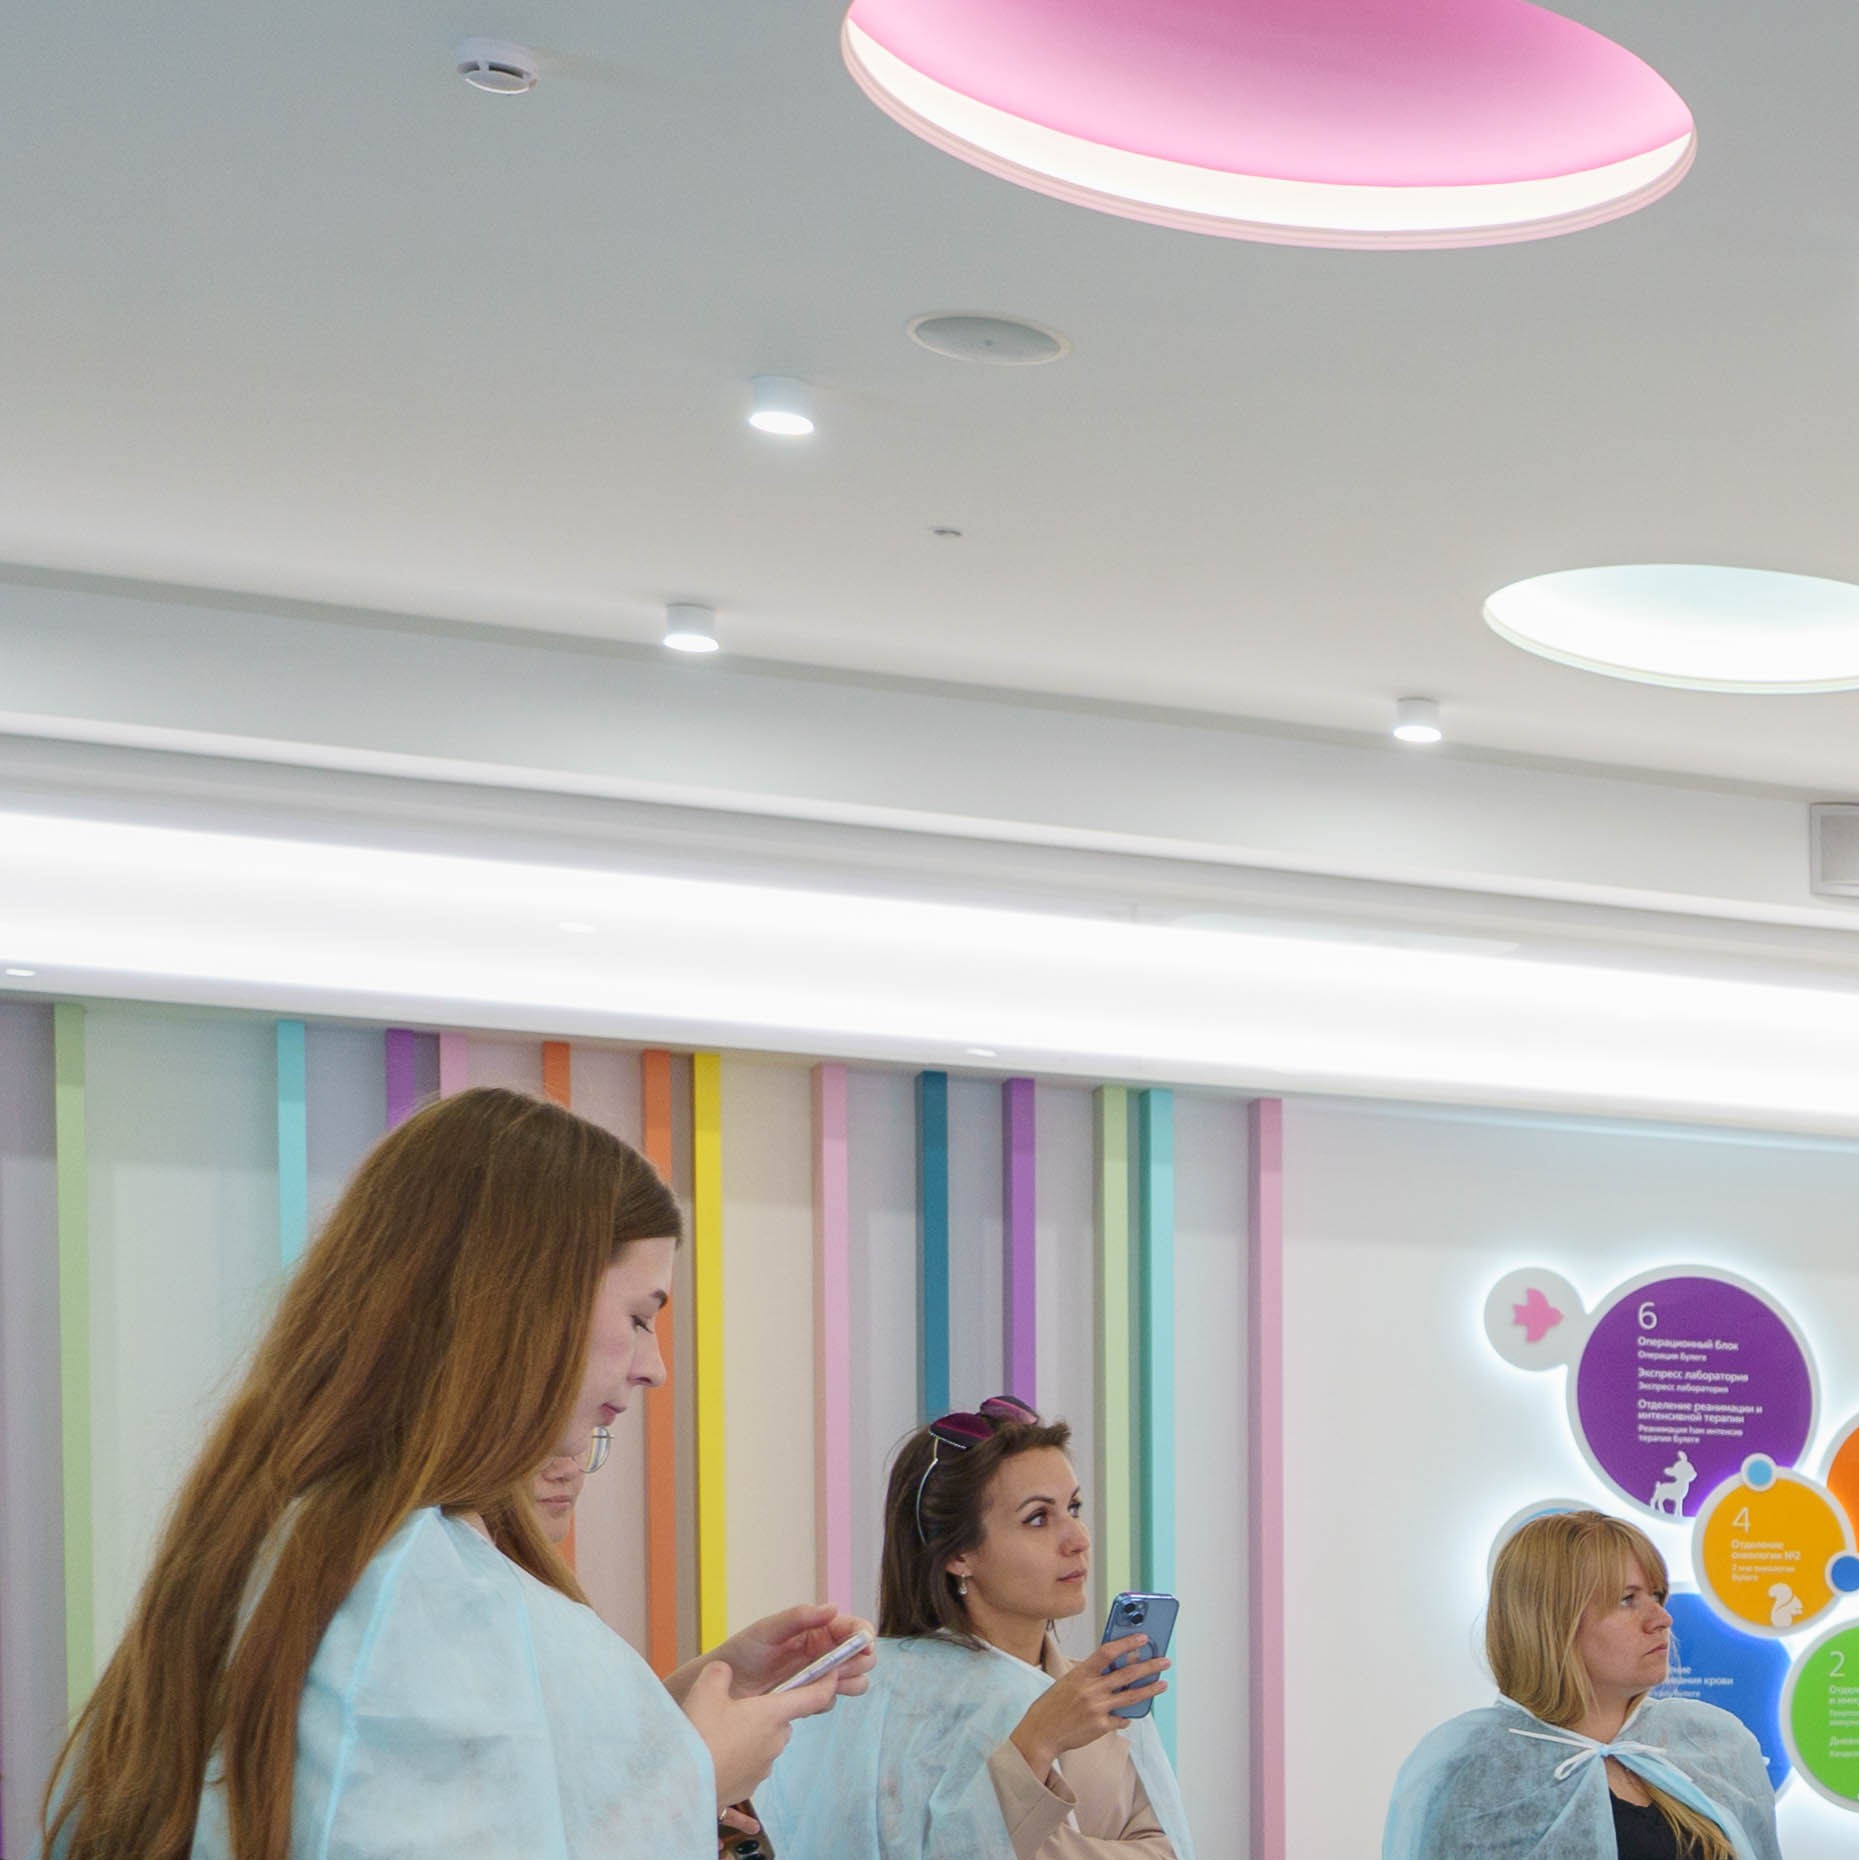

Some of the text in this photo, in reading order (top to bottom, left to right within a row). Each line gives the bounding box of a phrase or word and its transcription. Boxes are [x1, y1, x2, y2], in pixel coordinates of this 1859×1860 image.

[1638, 1301, 1658, 1330] 6
[1732, 1507, 1751, 1533] 4
[1829, 1650, 1845, 1678] 2
